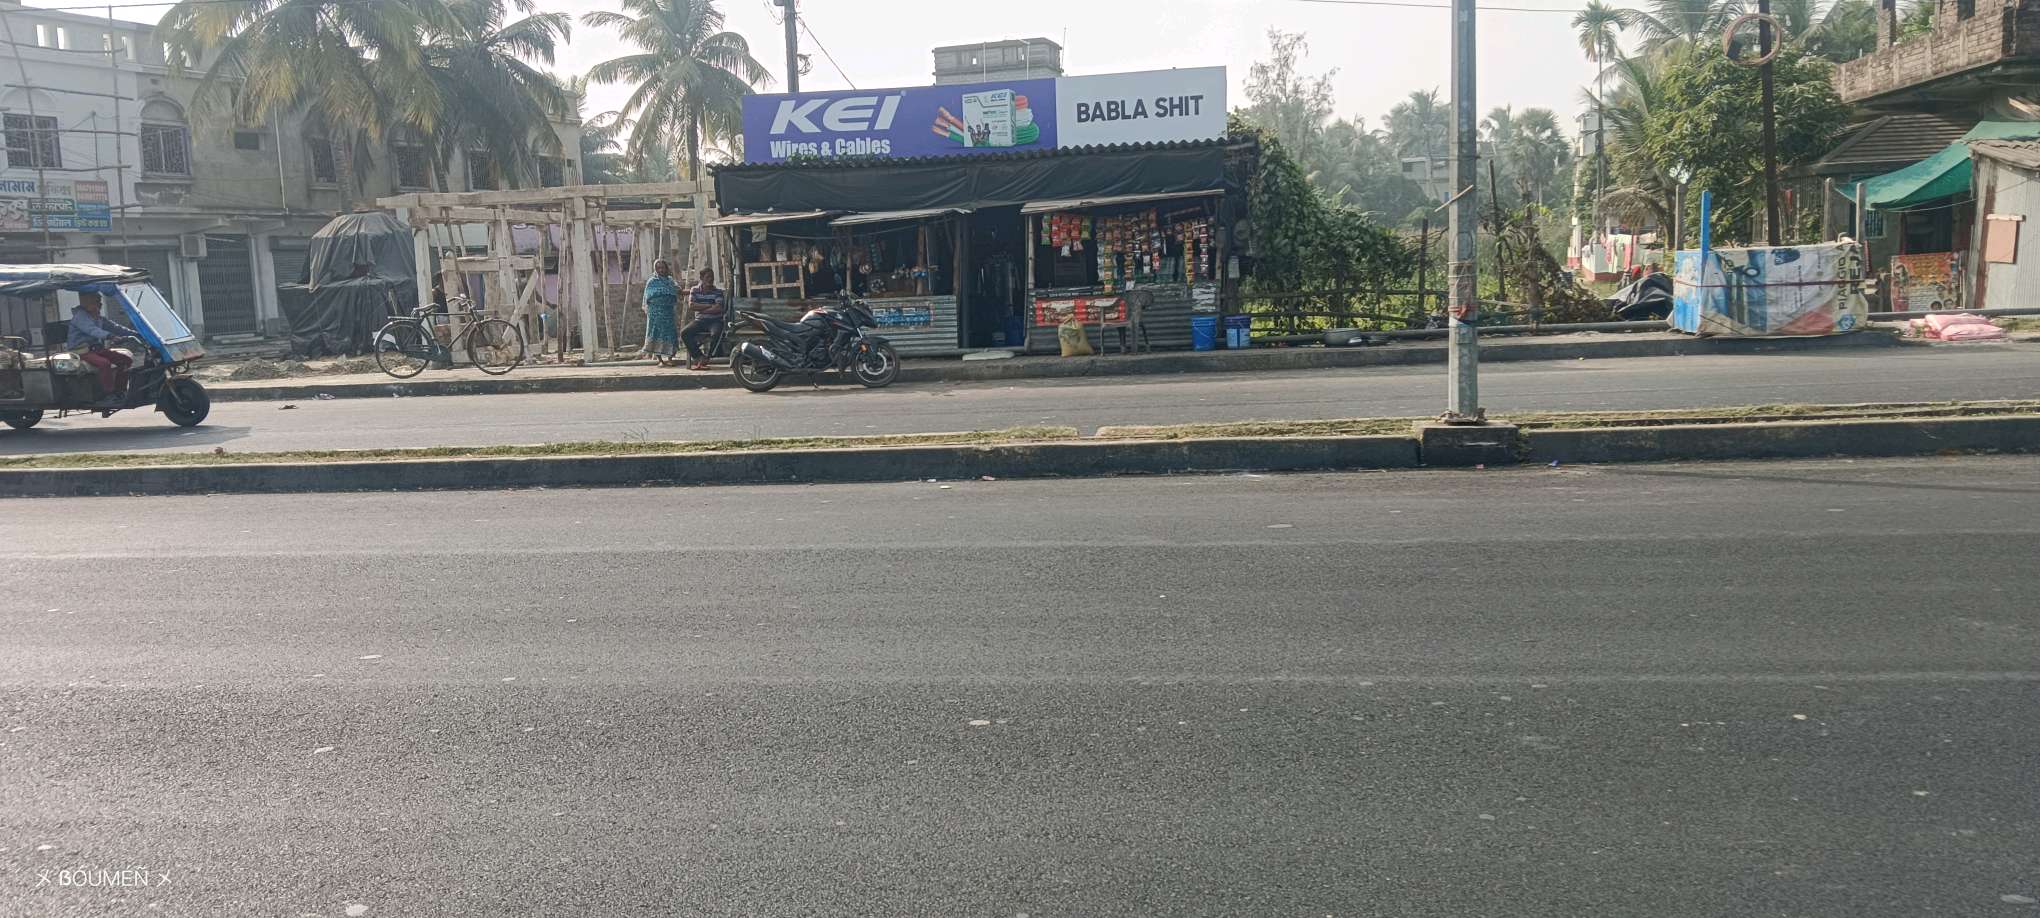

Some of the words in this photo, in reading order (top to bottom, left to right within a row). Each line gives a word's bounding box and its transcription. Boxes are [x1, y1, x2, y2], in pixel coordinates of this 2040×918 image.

[769, 95, 902, 134] KEI
[1077, 99, 1148, 123] BABLA
[1155, 95, 1204, 118] SHIT
[770, 139, 818, 158] Wires
[821, 141, 832, 156] &
[835, 137, 891, 156] Cables
